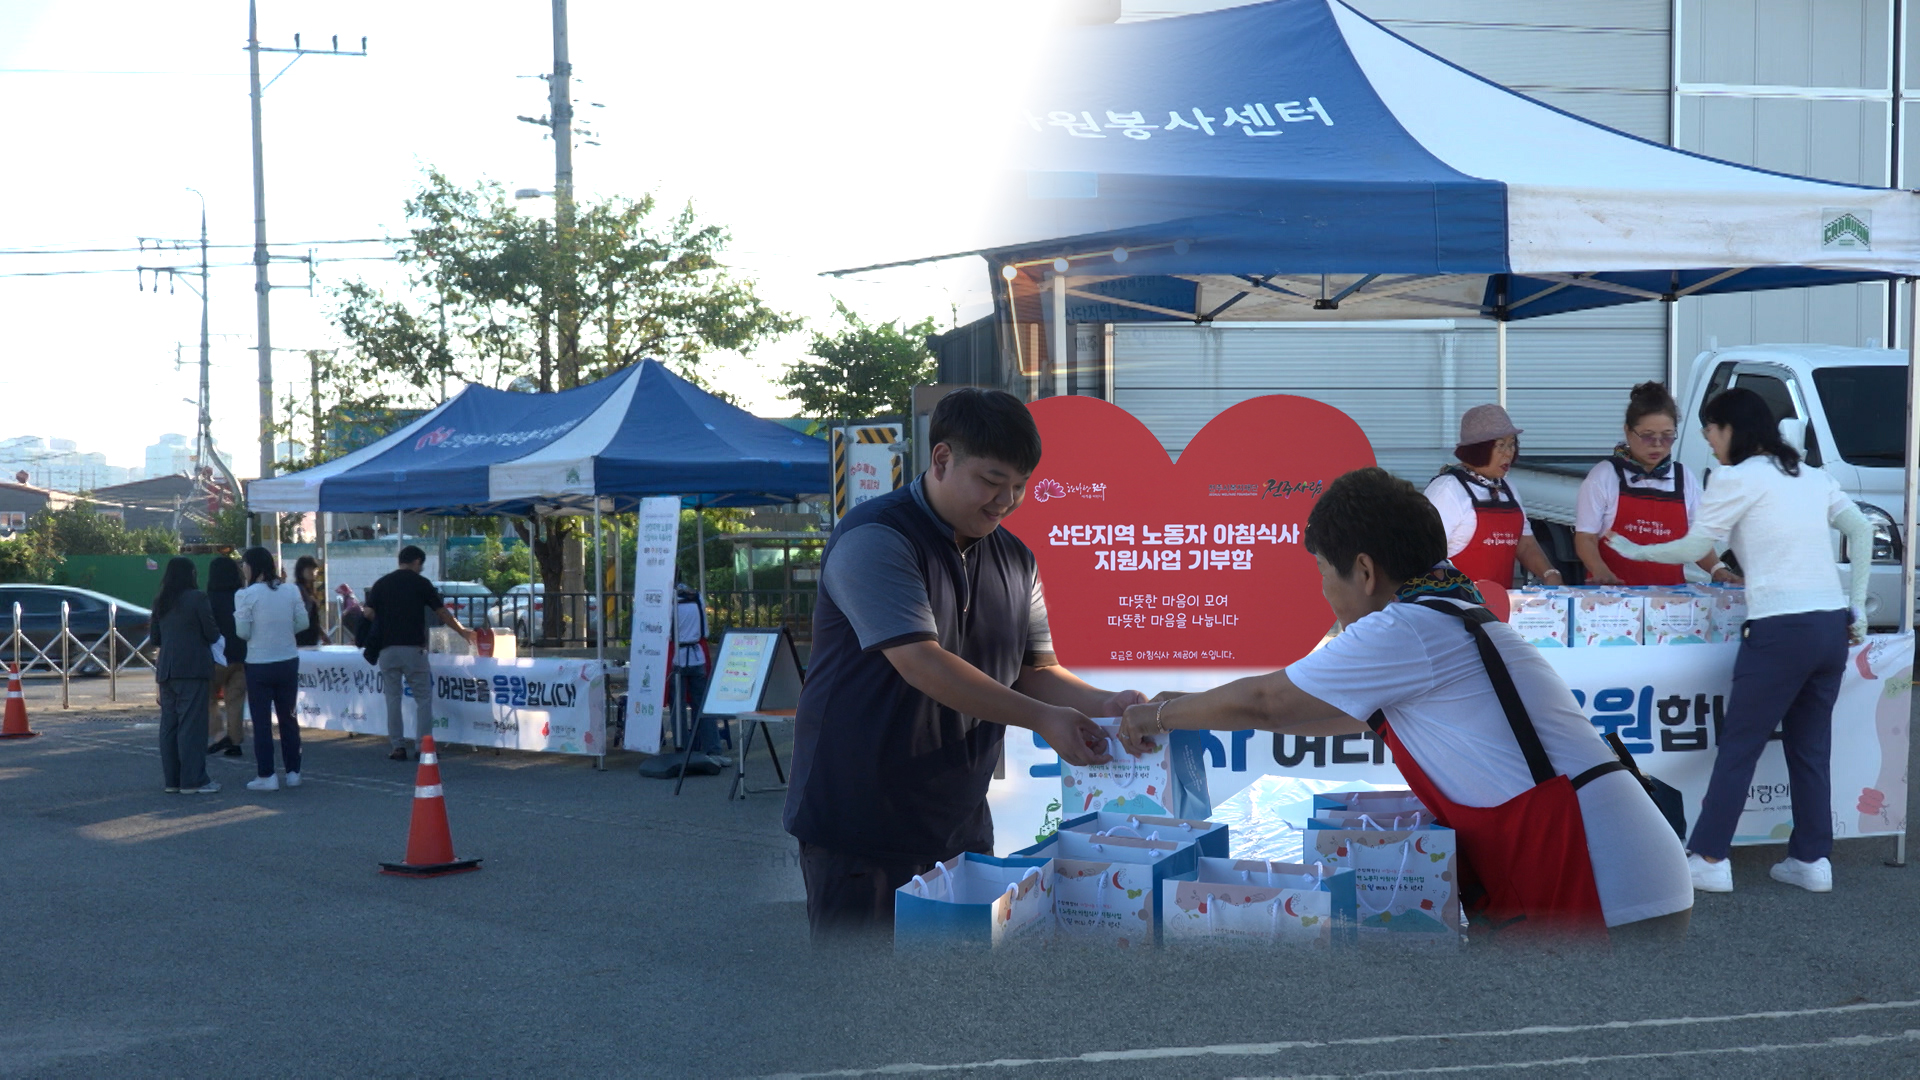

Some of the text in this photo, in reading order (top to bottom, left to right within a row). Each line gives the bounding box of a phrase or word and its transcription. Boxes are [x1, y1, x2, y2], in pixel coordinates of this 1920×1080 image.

[1824, 216, 1870, 244] CARAVAN
[1261, 478, 1323, 500] 전주사람
[1048, 523, 1300, 545] 산단지역 노동자 아침식사
[1094, 549, 1253, 571] 지원사업 기부함
[1119, 594, 1228, 608] 따뜻한 마음이 모여
[1108, 614, 1239, 628] 따뜻한 마음을 나눕니다
[1110, 650, 1235, 661] 모금은 아침식사 제공에 쓰입니다.
[438, 676, 490, 703] 여러분을
[492, 674, 576, 707] 응원합니다!
